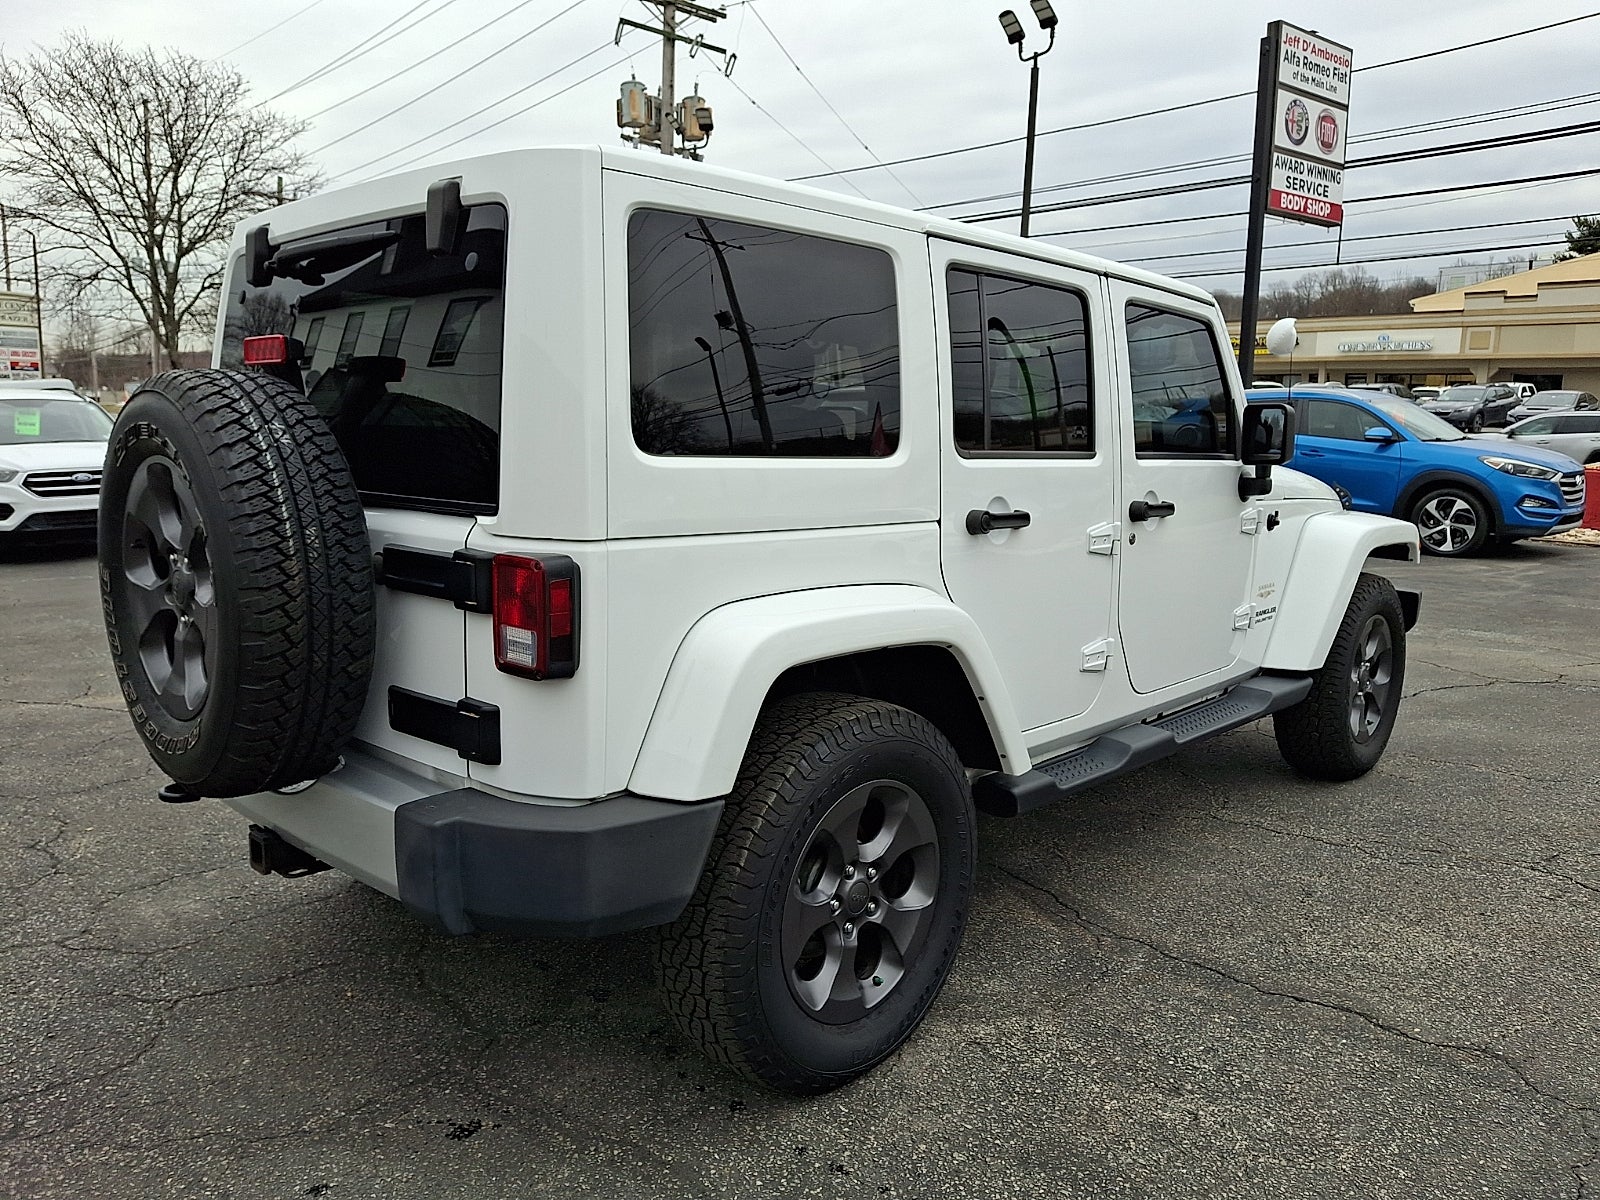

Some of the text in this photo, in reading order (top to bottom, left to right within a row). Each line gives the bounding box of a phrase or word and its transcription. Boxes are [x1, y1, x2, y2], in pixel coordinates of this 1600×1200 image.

[1283, 33, 1350, 68] Jeff D'Ambrosio
[1283, 48, 1348, 85] Alfa Romeo Fiat
[1292, 70, 1338, 94] of the Main Line
[1321, 121, 1335, 144] FIAT
[1274, 155, 1342, 185] AWARD WINNING
[1285, 175, 1330, 199] SERVICE
[1280, 192, 1331, 217] BODY SHOP
[1256, 607, 1276, 616] RANGLER
